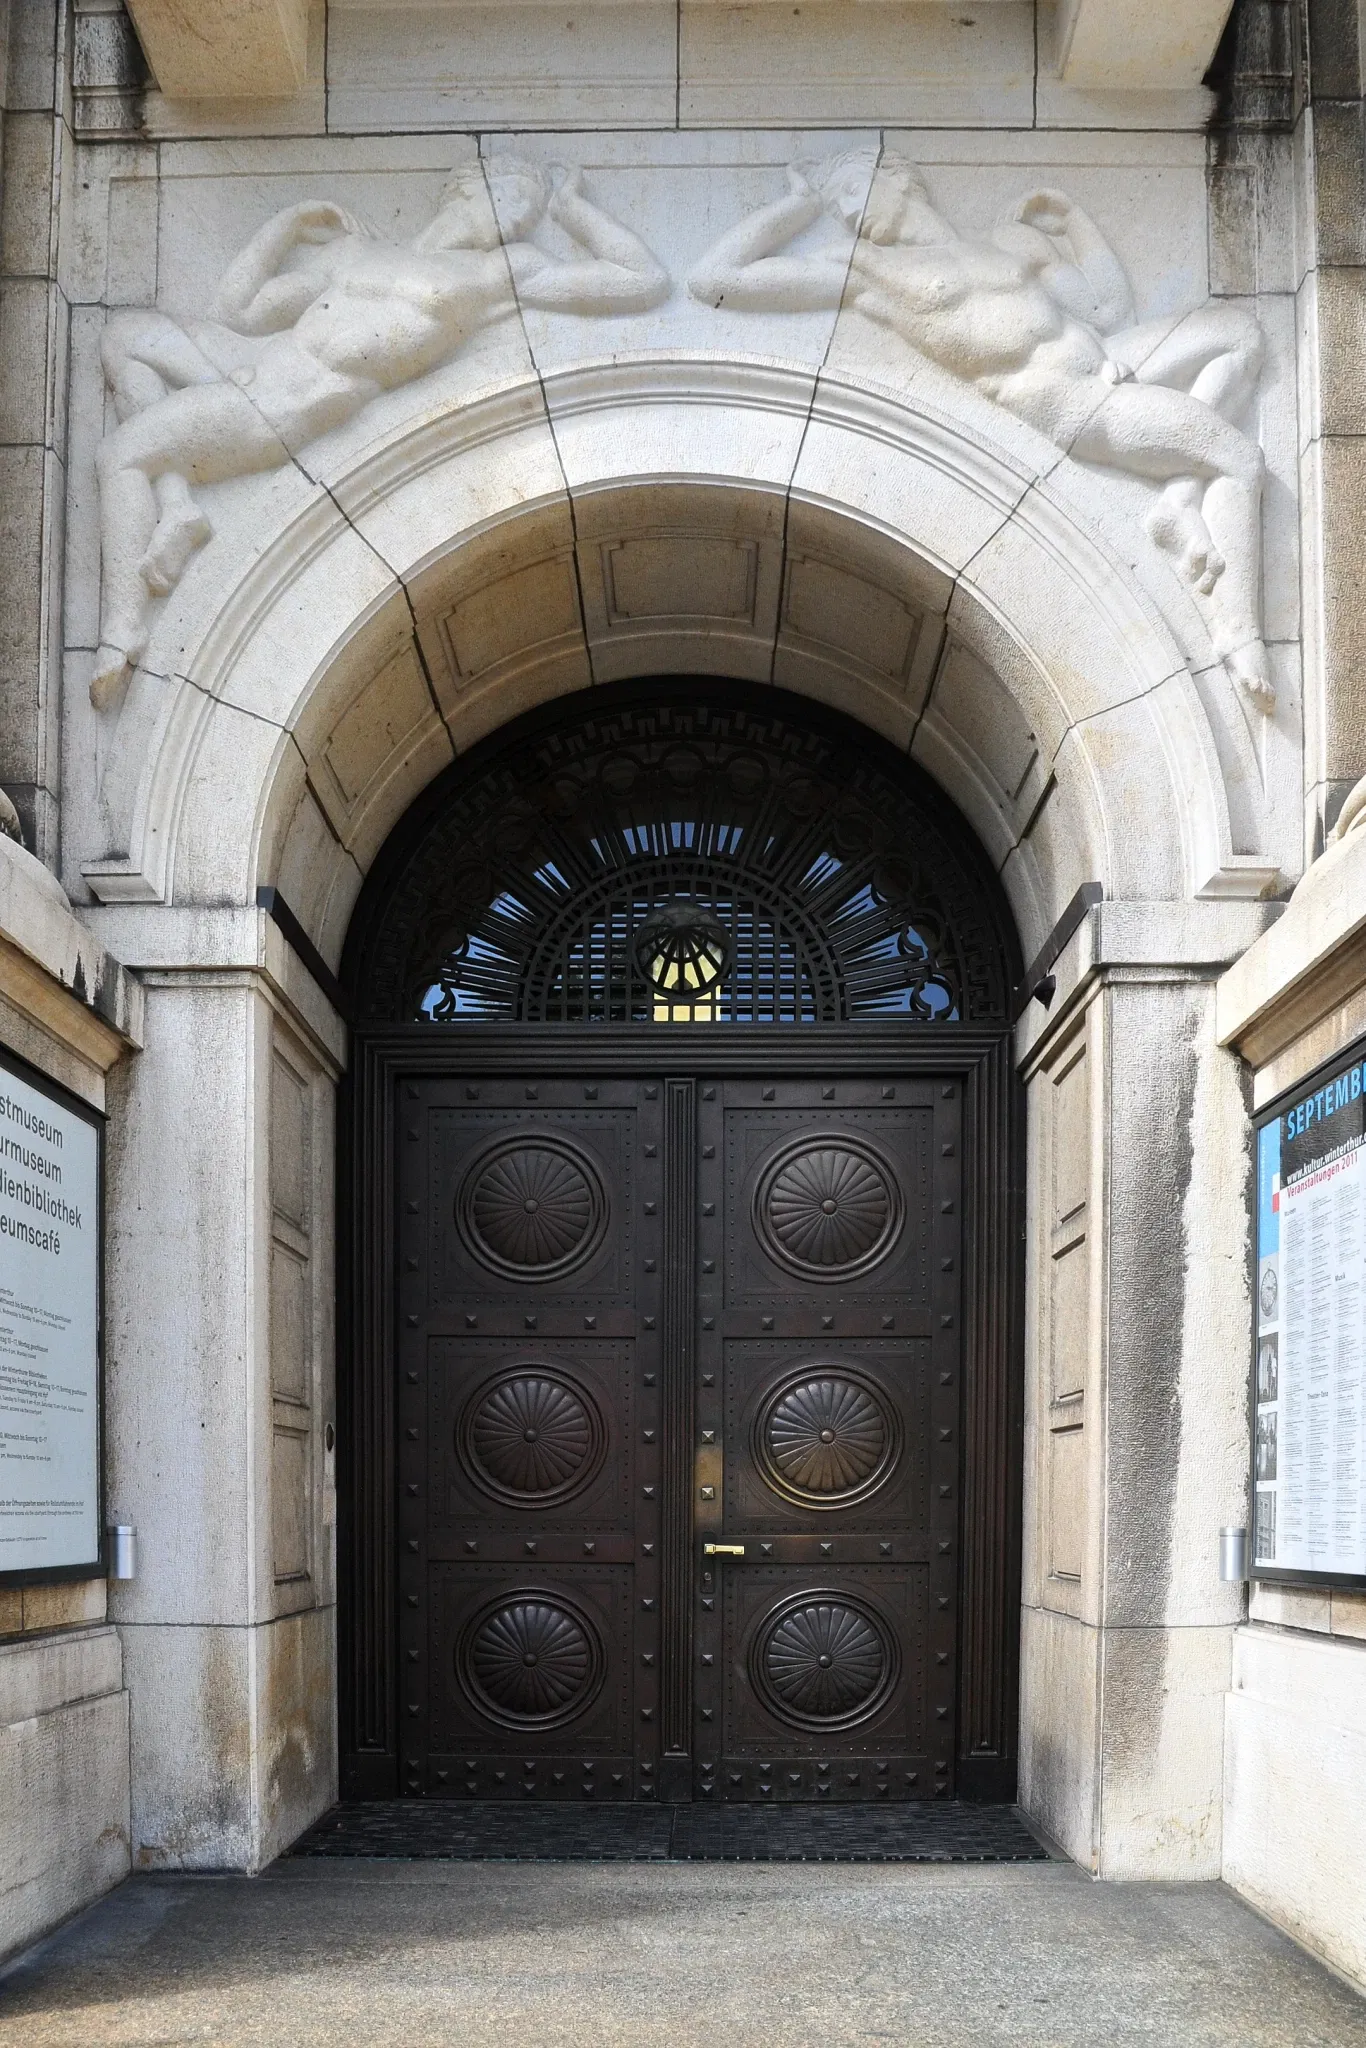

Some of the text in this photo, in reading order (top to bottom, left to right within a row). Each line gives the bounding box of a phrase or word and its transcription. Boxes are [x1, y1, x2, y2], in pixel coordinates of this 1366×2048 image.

[1287, 1163, 1340, 1198] Veranstaltungen
[1342, 1151, 1358, 1170] 2011
[0, 1214, 61, 1255] eumscafé
